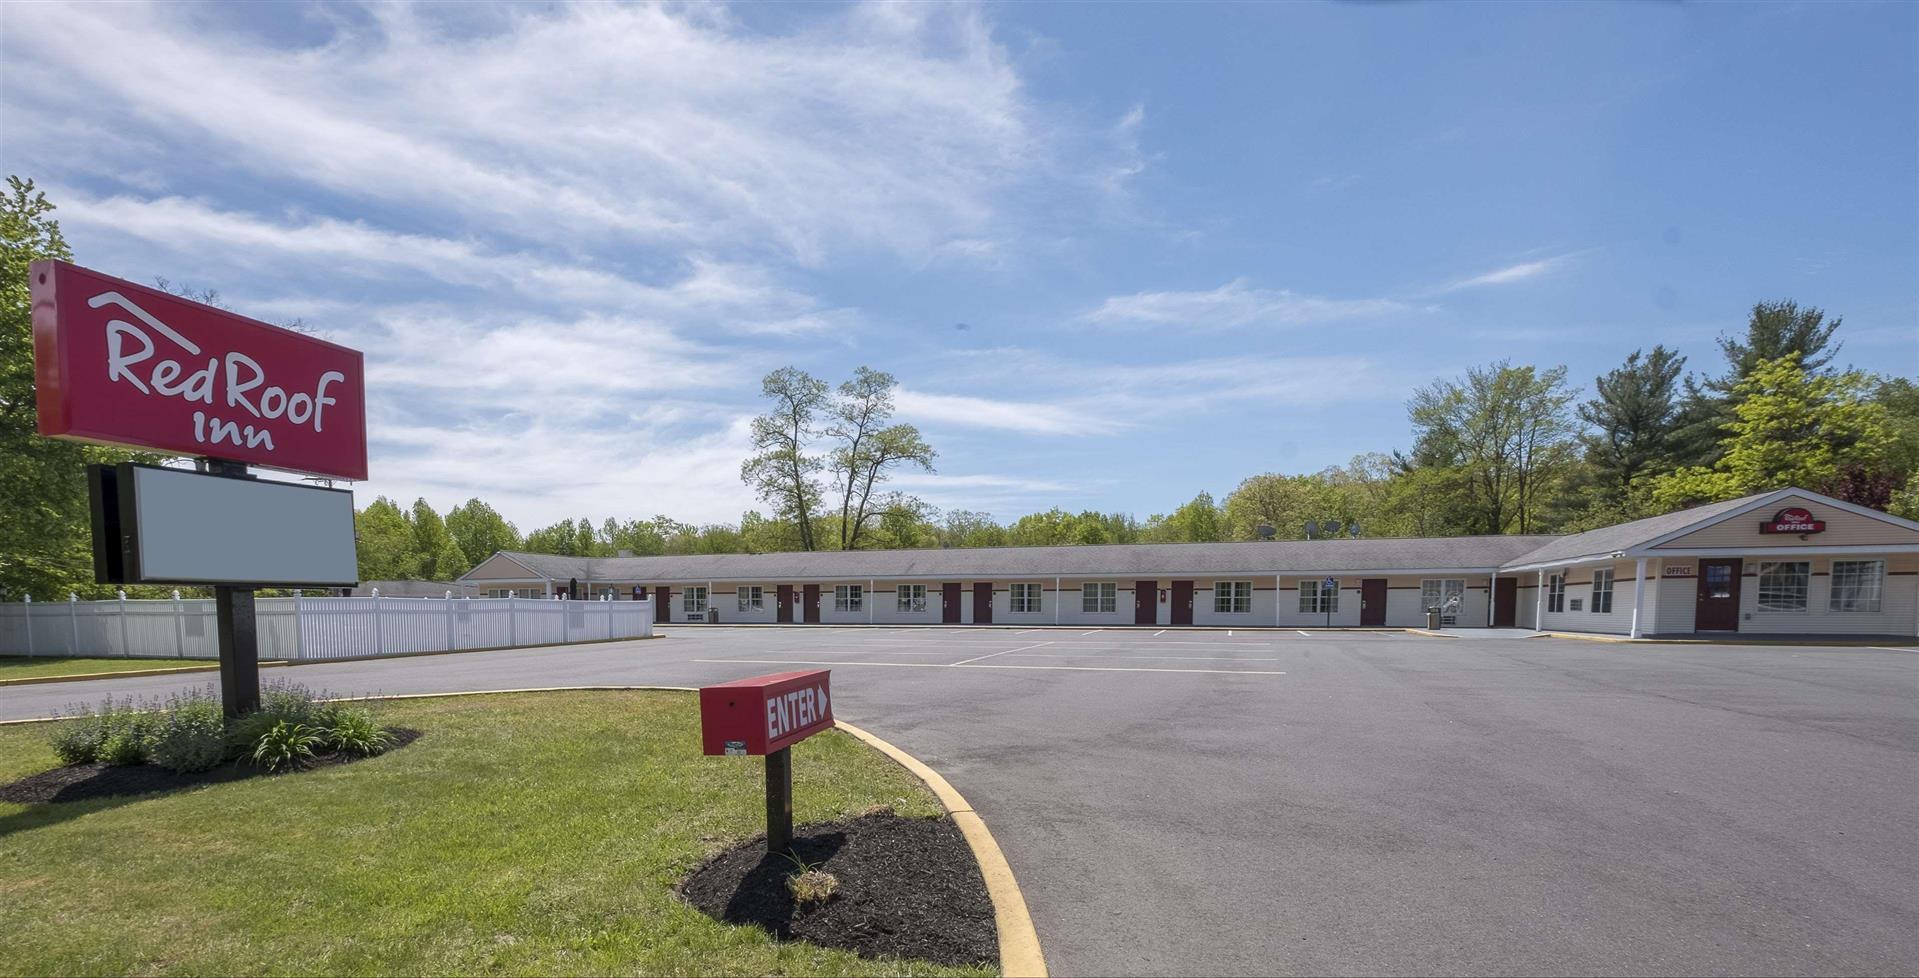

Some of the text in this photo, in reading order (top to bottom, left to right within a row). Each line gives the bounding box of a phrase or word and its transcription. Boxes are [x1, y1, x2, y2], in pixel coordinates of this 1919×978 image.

[1776, 523, 1815, 531] OFFICE
[1665, 566, 1691, 575] OFFICE
[767, 687, 817, 739] ENTER
